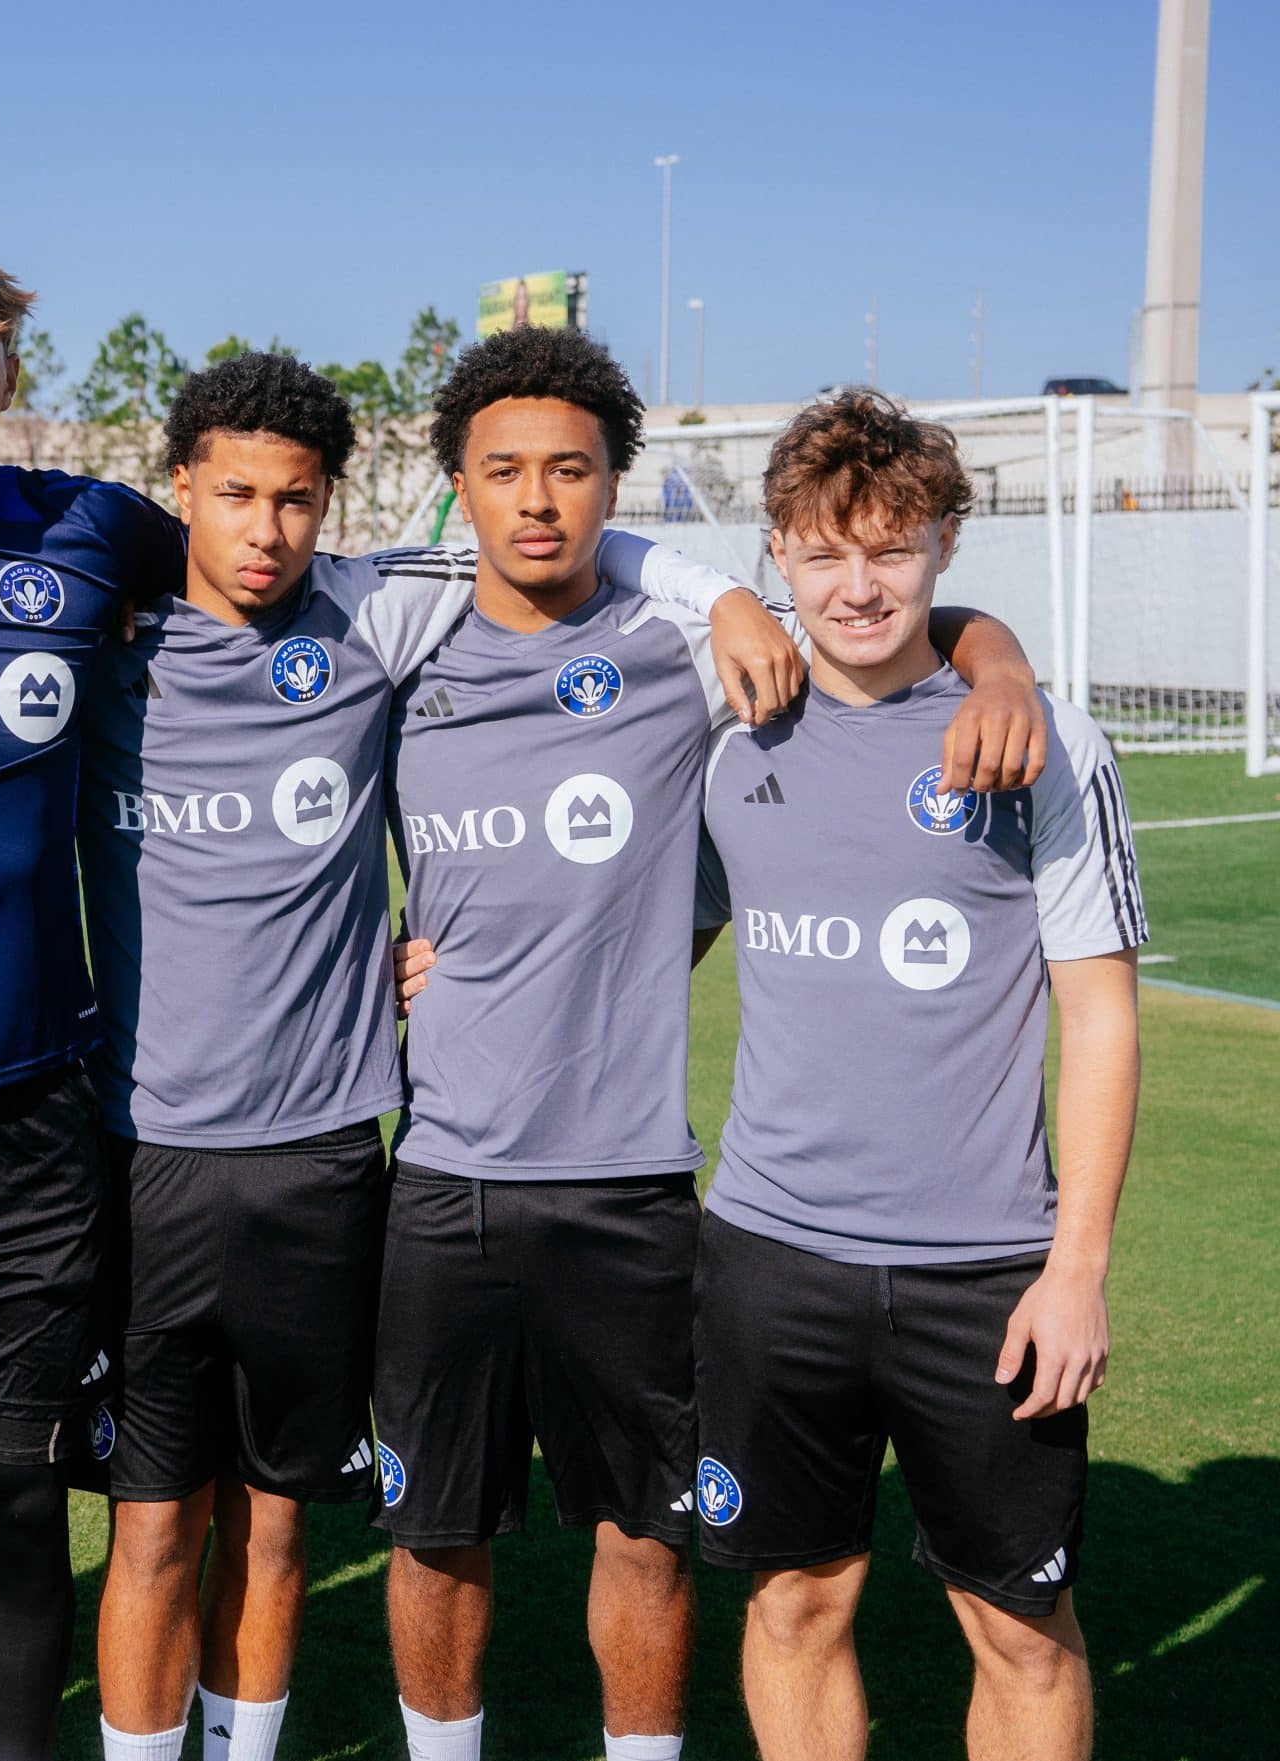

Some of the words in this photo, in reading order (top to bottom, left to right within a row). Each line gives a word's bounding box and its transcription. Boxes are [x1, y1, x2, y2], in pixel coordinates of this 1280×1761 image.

[3, 578, 11, 591] CF
[10, 567, 56, 591] MONTRÉAL
[276, 662, 282, 675] CF
[281, 642, 325, 662] MONTRÉAL
[561, 676, 568, 689] CF
[568, 660, 616, 681] MONTRÉAL
[915, 783, 924, 796] CF
[113, 789, 252, 834] BMO
[406, 806, 525, 855] BMO
[745, 907, 861, 960] BMO
[703, 1464, 735, 1497] MONTRÉAL
